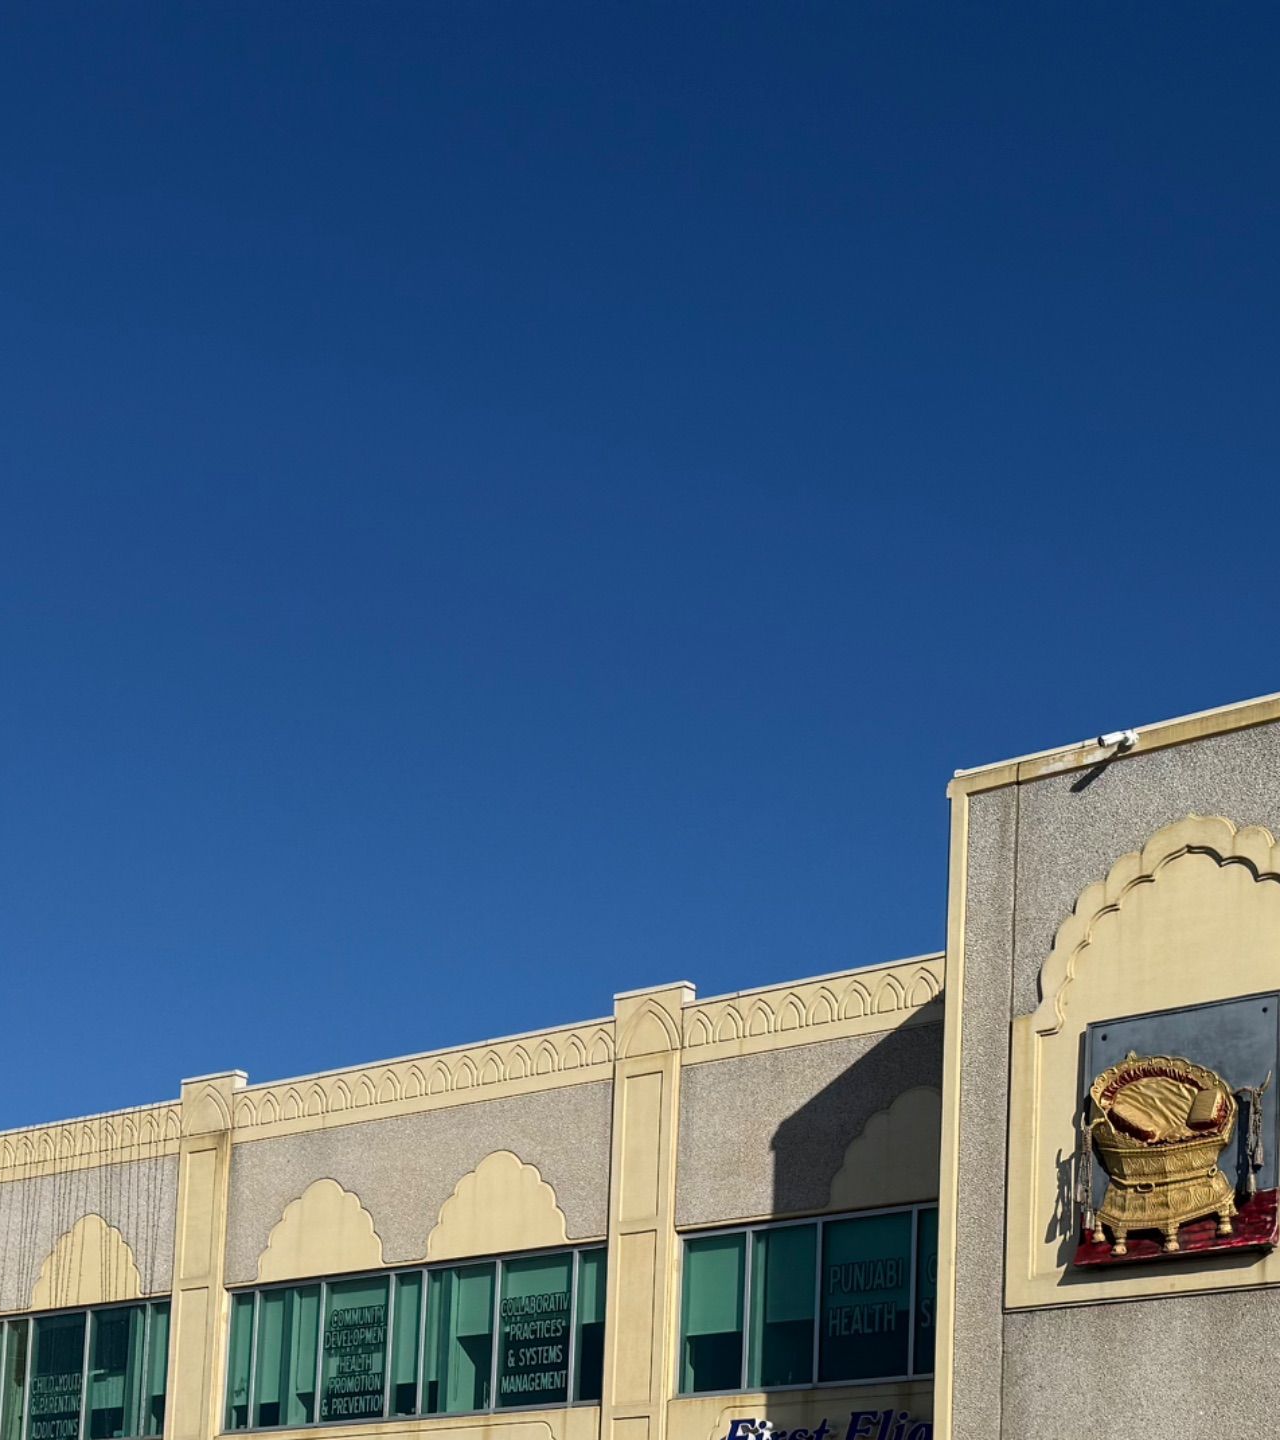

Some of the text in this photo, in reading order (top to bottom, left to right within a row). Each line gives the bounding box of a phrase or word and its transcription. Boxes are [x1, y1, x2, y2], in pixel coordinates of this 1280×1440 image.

[828, 1257, 903, 1293] PUNJABI
[501, 1293, 570, 1316] COLLABORATIV
[331, 1306, 385, 1328] COMMUNITY
[828, 1302, 896, 1337] HEALTH
[325, 1326, 385, 1348] DEVELOPMEN
[510, 1319, 563, 1340] PRACTICES
[339, 1354, 372, 1372] HEALTH
[507, 1345, 563, 1368] & SYSTEMS
[328, 1374, 380, 1394] PROMOTION
[501, 1370, 566, 1393] MANAGEMENT
[321, 1399, 328, 1416] &
[32, 1419, 79, 1439] ADDICTIONS
